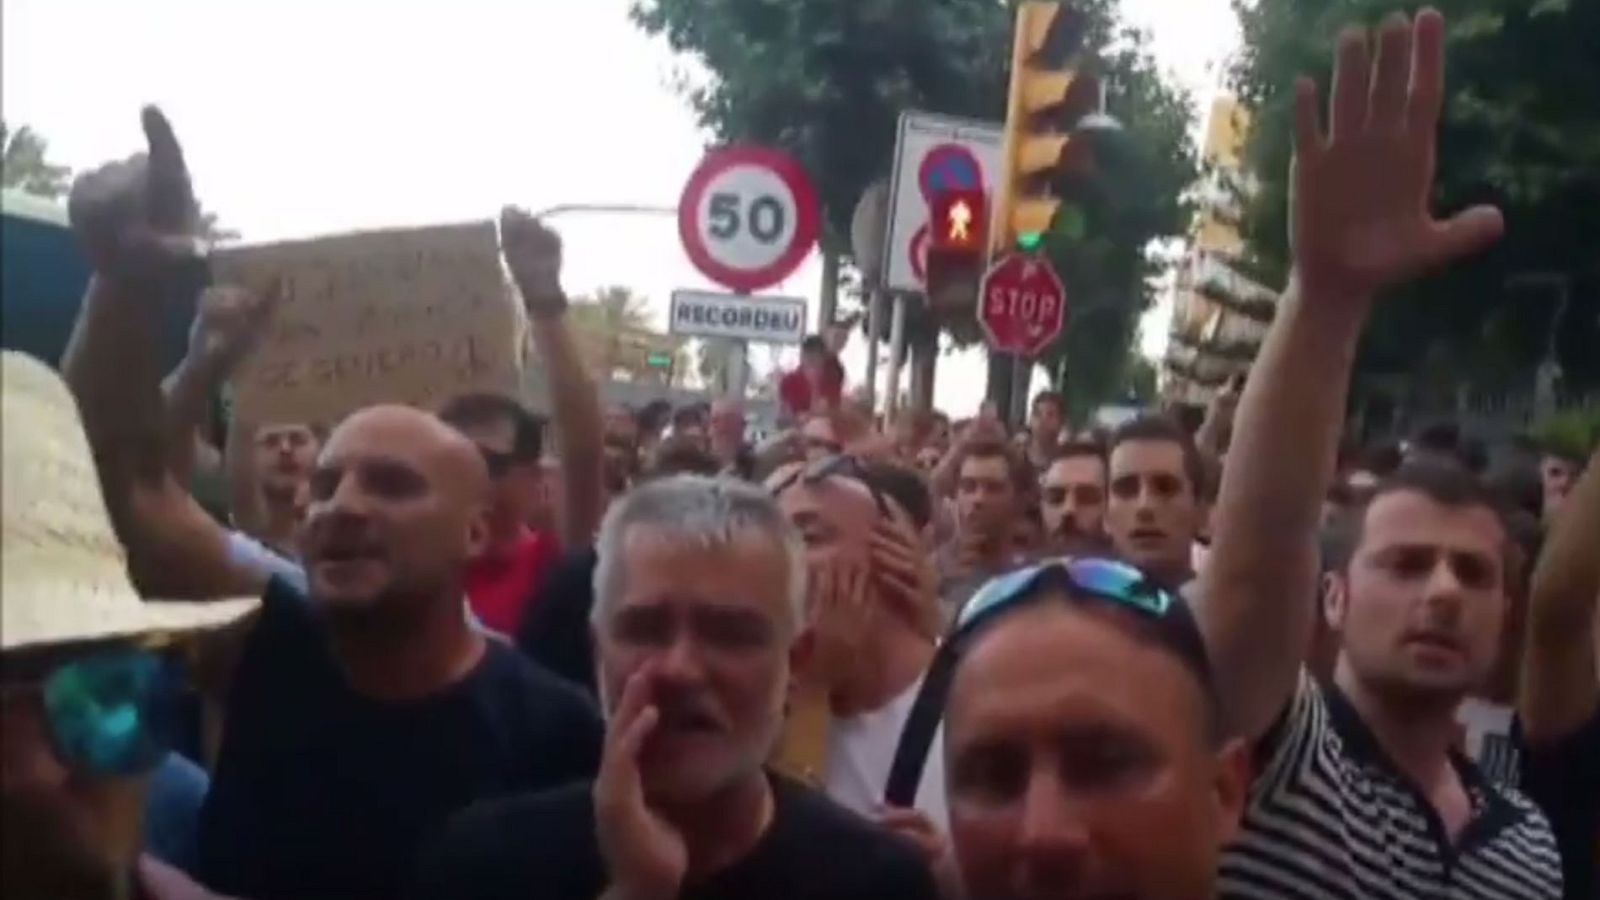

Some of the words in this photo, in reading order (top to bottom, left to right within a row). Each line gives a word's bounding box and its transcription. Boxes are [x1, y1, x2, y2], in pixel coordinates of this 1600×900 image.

[708, 192, 785, 245] 50
[677, 303, 799, 331] RECORDEU
[989, 286, 1057, 322] STOP
